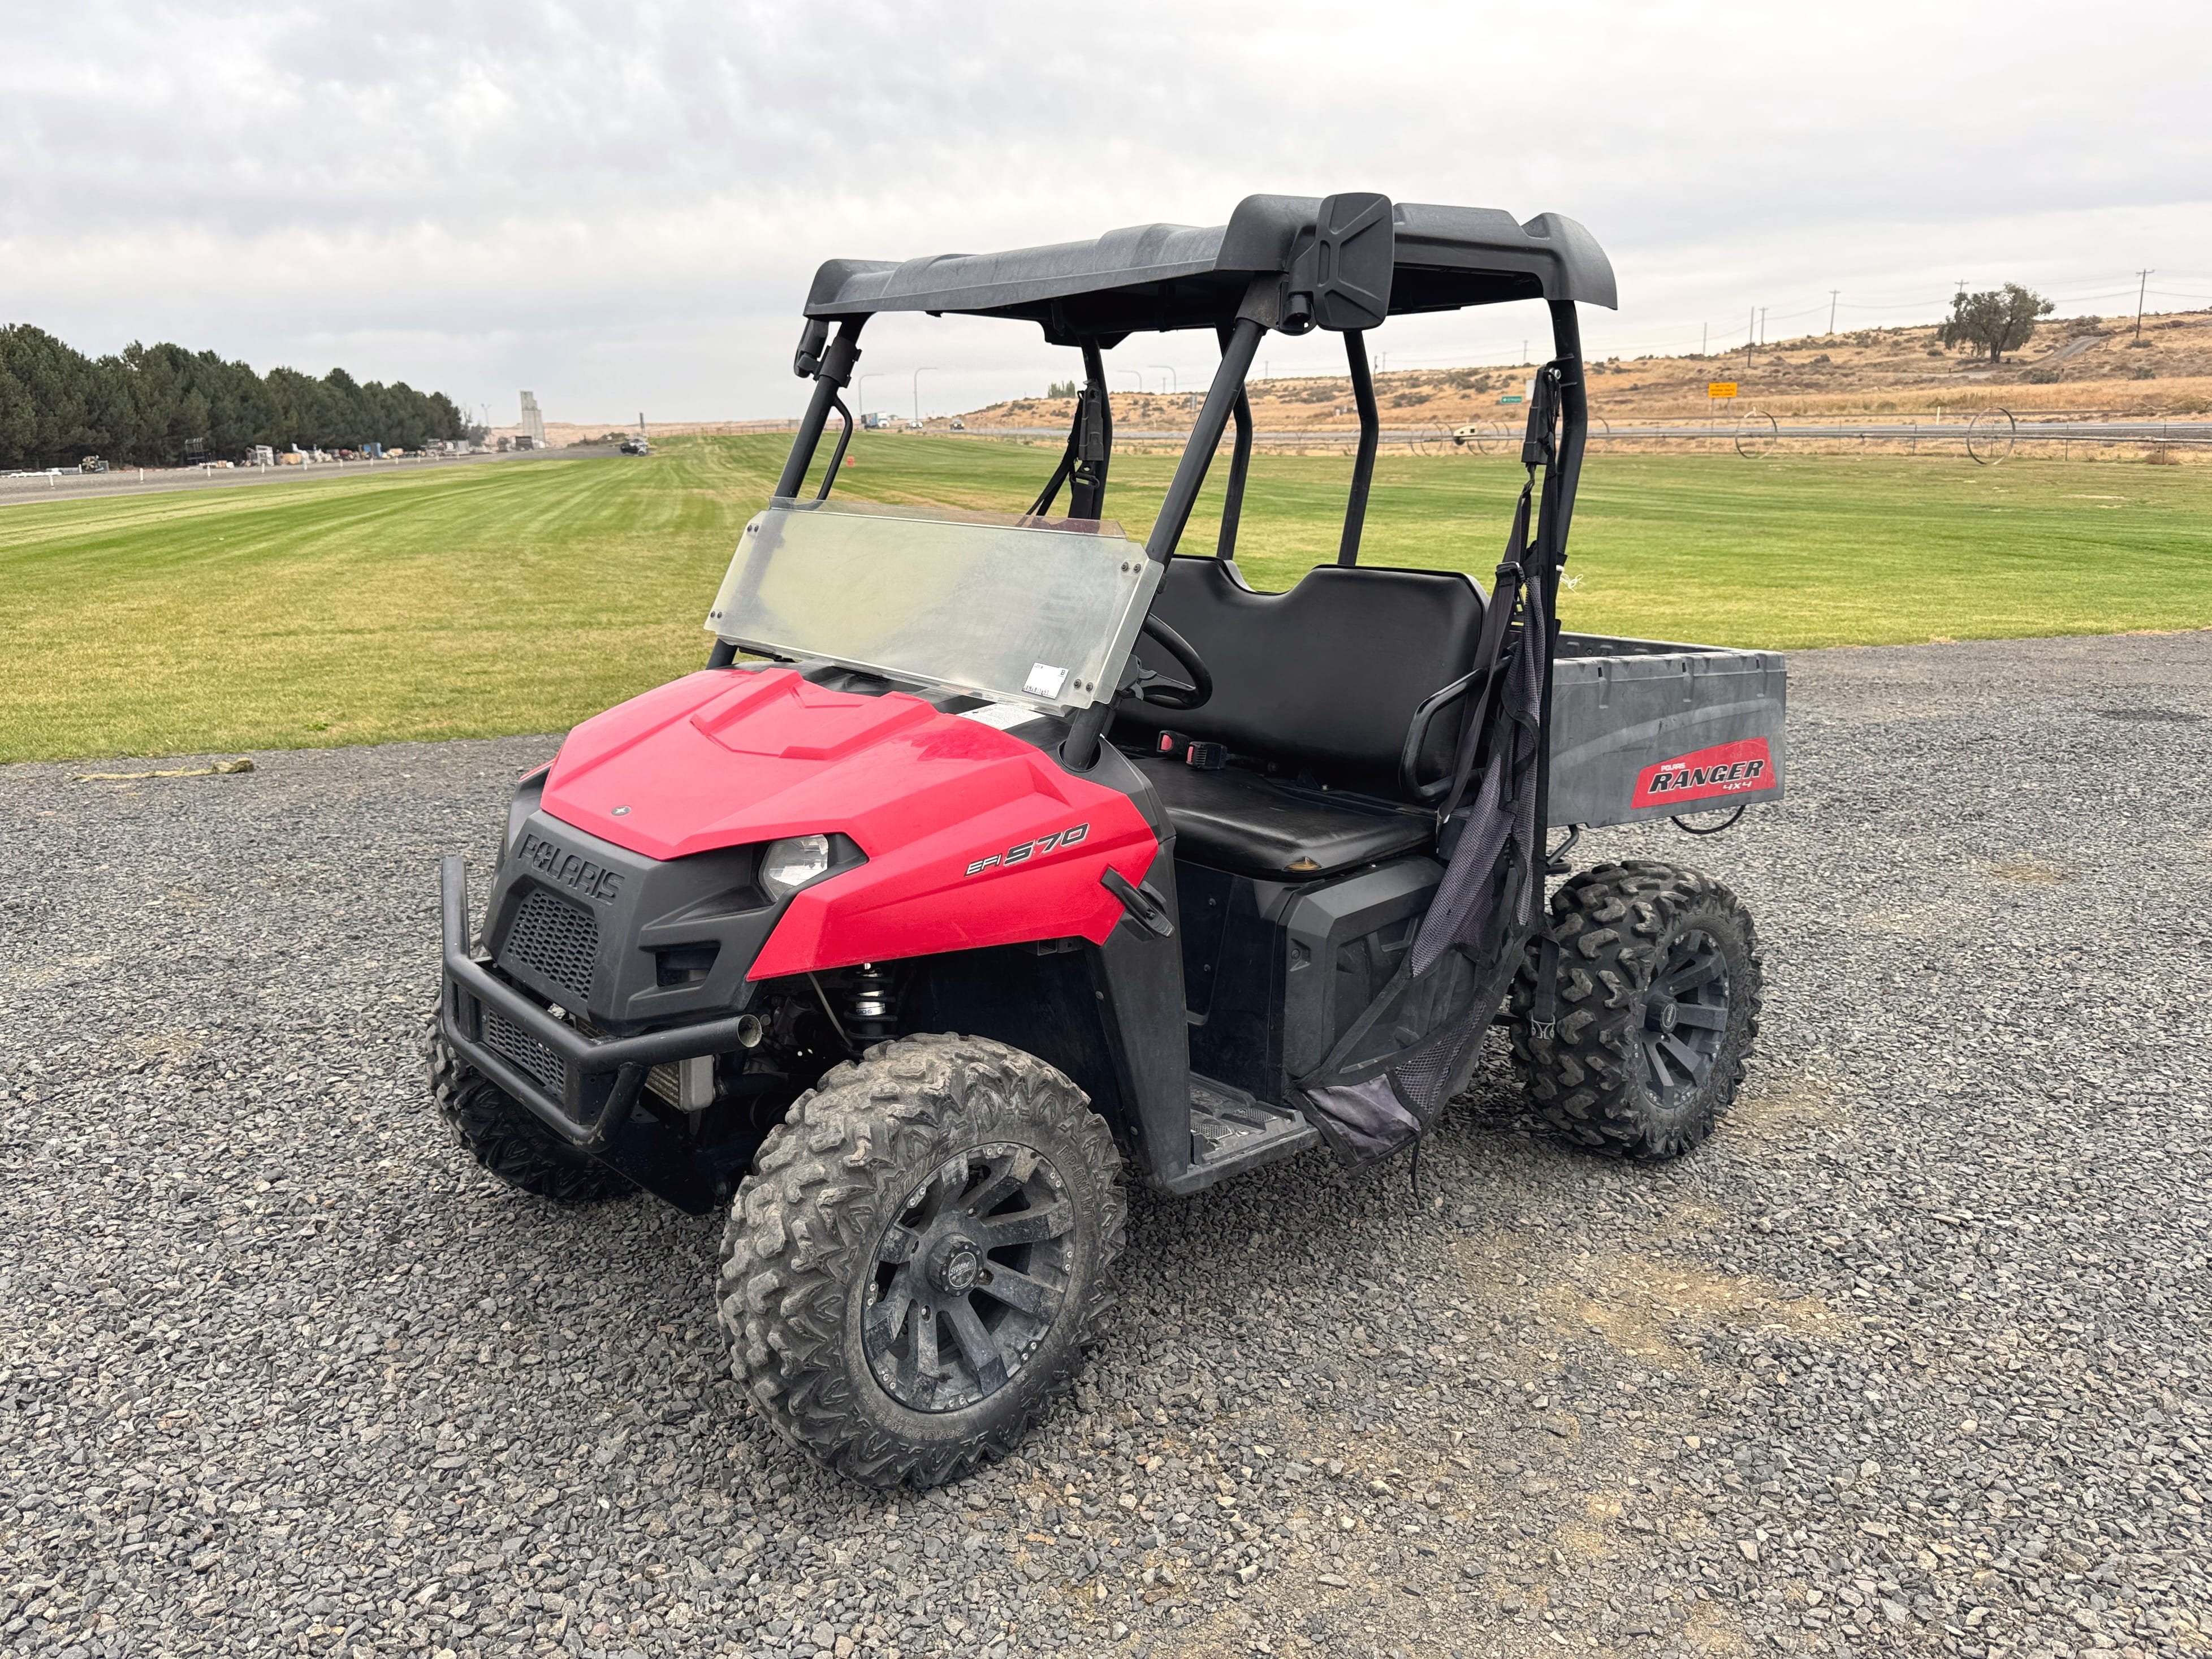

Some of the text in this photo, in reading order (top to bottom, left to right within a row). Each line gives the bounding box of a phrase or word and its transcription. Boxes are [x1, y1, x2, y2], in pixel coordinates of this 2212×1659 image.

[1647, 759, 1764, 794] RANGER
[1661, 762, 1686, 772] POLARIS
[517, 833, 625, 906] POLARIS
[964, 822, 1090, 877] EFI 570
